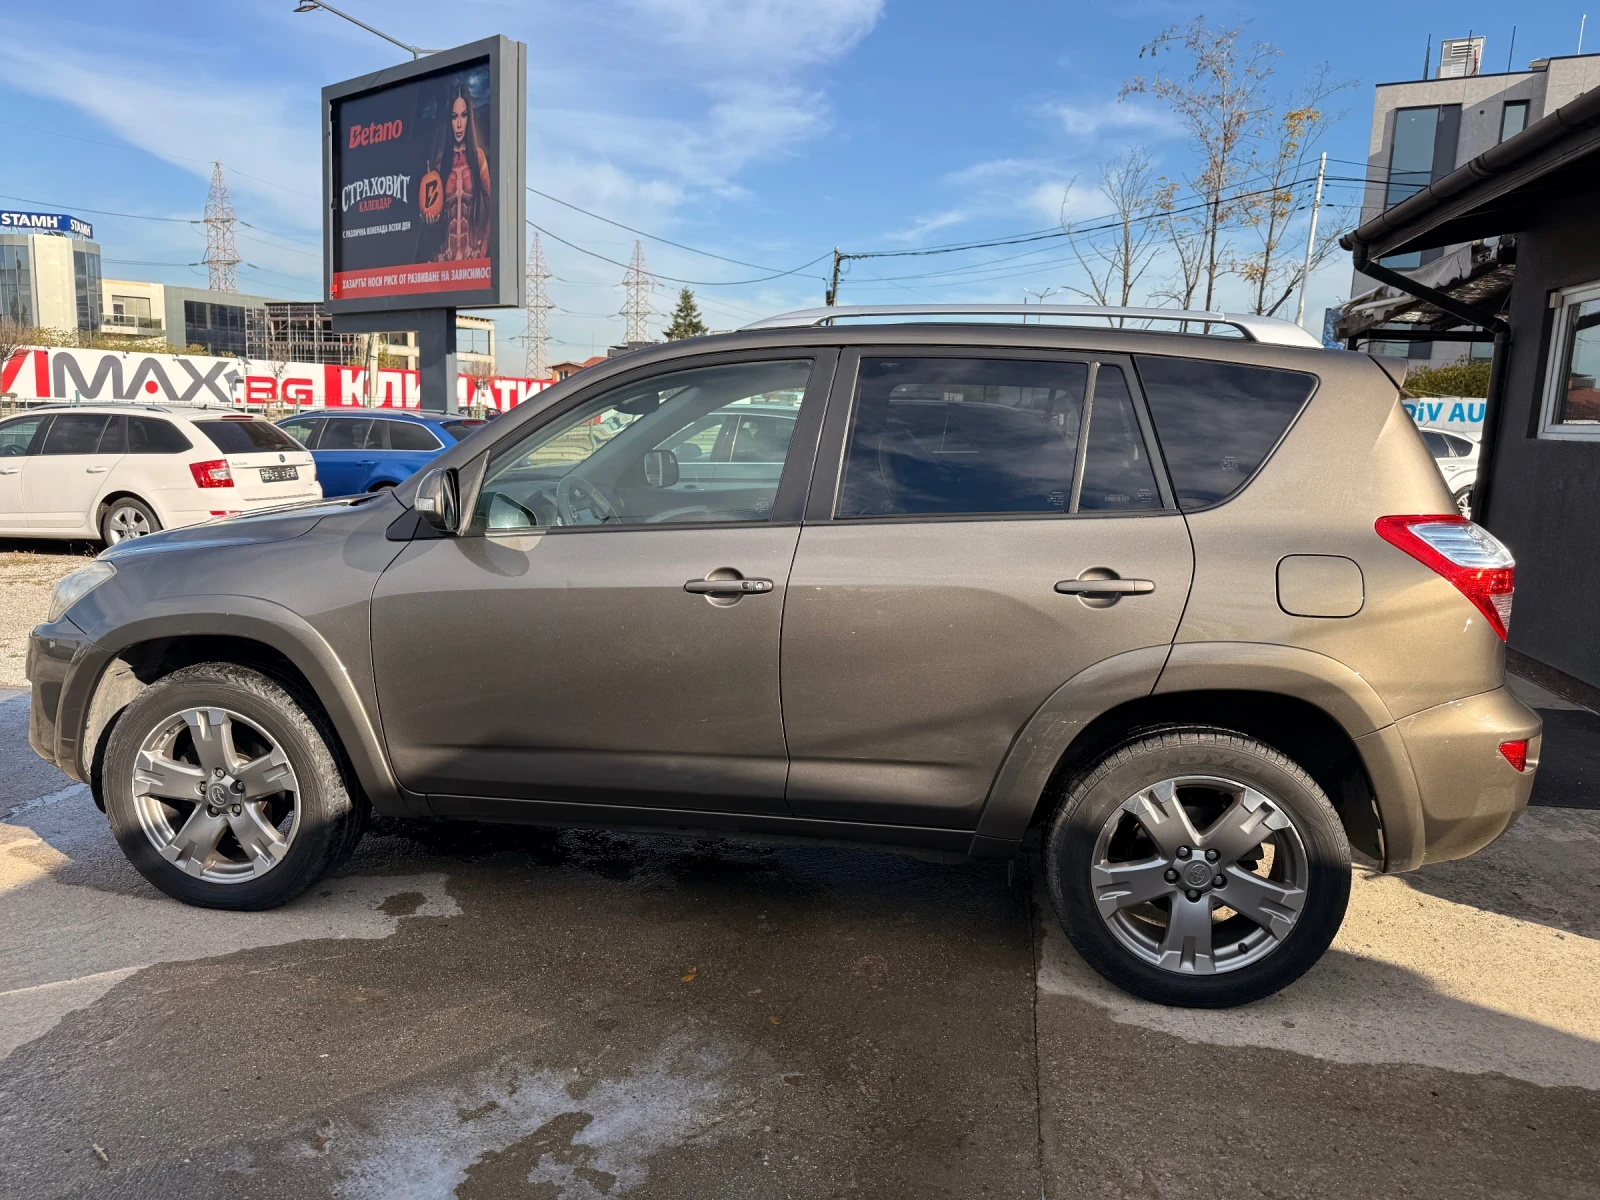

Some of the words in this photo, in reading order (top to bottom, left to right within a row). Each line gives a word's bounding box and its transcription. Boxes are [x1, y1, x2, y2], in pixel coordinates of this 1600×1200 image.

[349, 120, 403, 149] Betano
[341, 173, 411, 212] СТРАХОВИТ
[359, 197, 392, 212] КАЛЕНДАР
[1, 213, 58, 228] STAMH
[70, 219, 91, 237] STAMH
[346, 227, 366, 238] РАЗЛИЧНА
[366, 224, 388, 235] ИЗНЕНАДА
[388, 222, 401, 232] ВСЕКИ
[402, 220, 411, 232] ДЕН
[342, 277, 367, 289] ХАЗАРТЪТ
[367, 276, 383, 287] НОСИ
[383, 274, 398, 286] РИСК
[399, 273, 407, 284] ОТ
[407, 271, 440, 284] РАЗВИВАНЕ
[440, 270, 450, 281] НА
